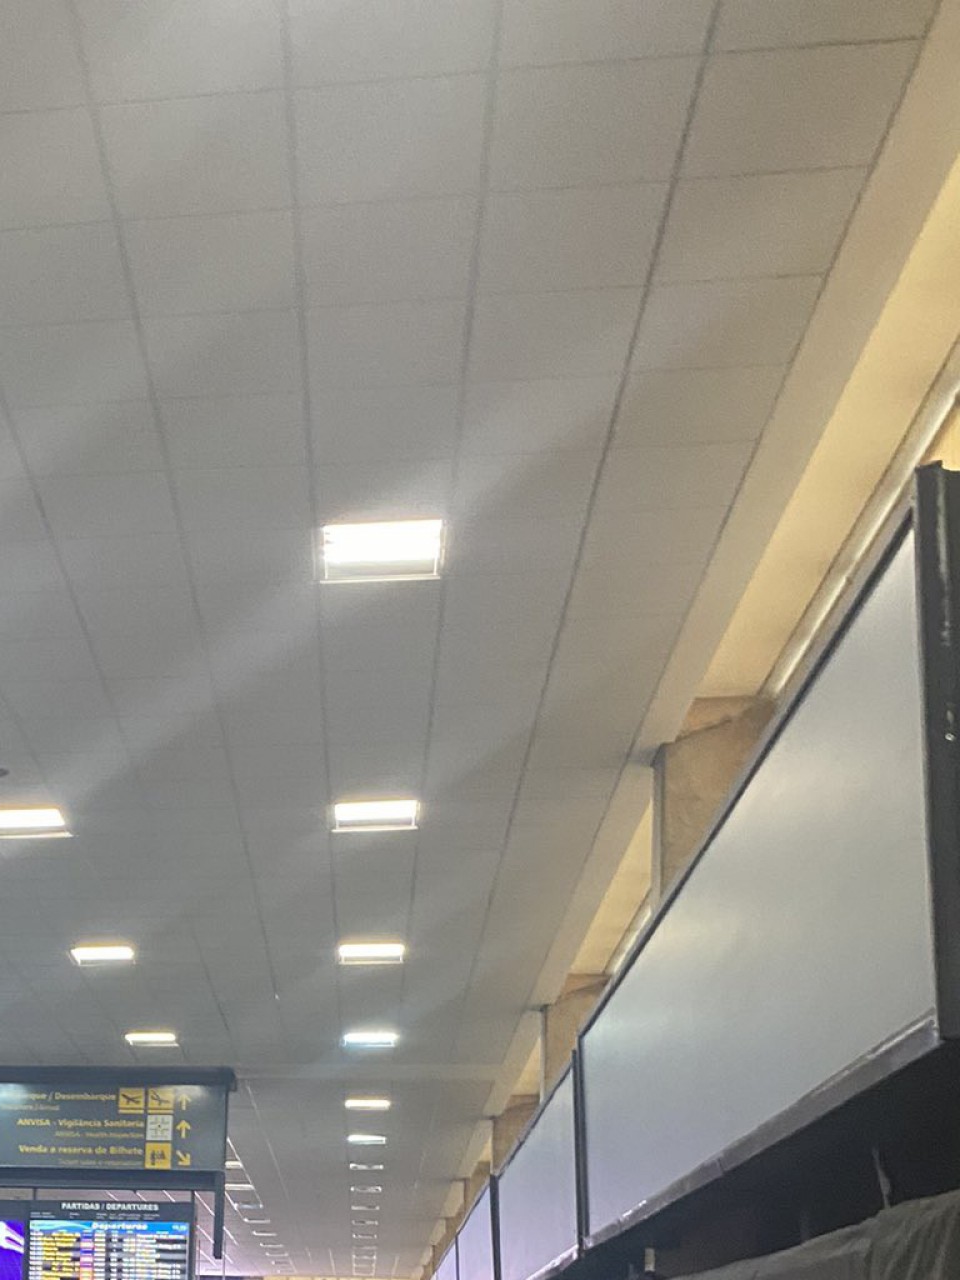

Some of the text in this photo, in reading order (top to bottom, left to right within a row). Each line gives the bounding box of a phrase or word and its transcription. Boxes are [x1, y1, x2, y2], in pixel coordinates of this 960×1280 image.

[16, 1117, 51, 1127] ANVISA
[18, 1144, 48, 1154] Venda
[50, 1146, 56, 1154] e
[58, 1146, 92, 1154] reserva
[94, 1145, 107, 1154] de
[61, 1202, 100, 1211] PARTIDAS
[105, 1202, 159, 1212] DEPARTURES
